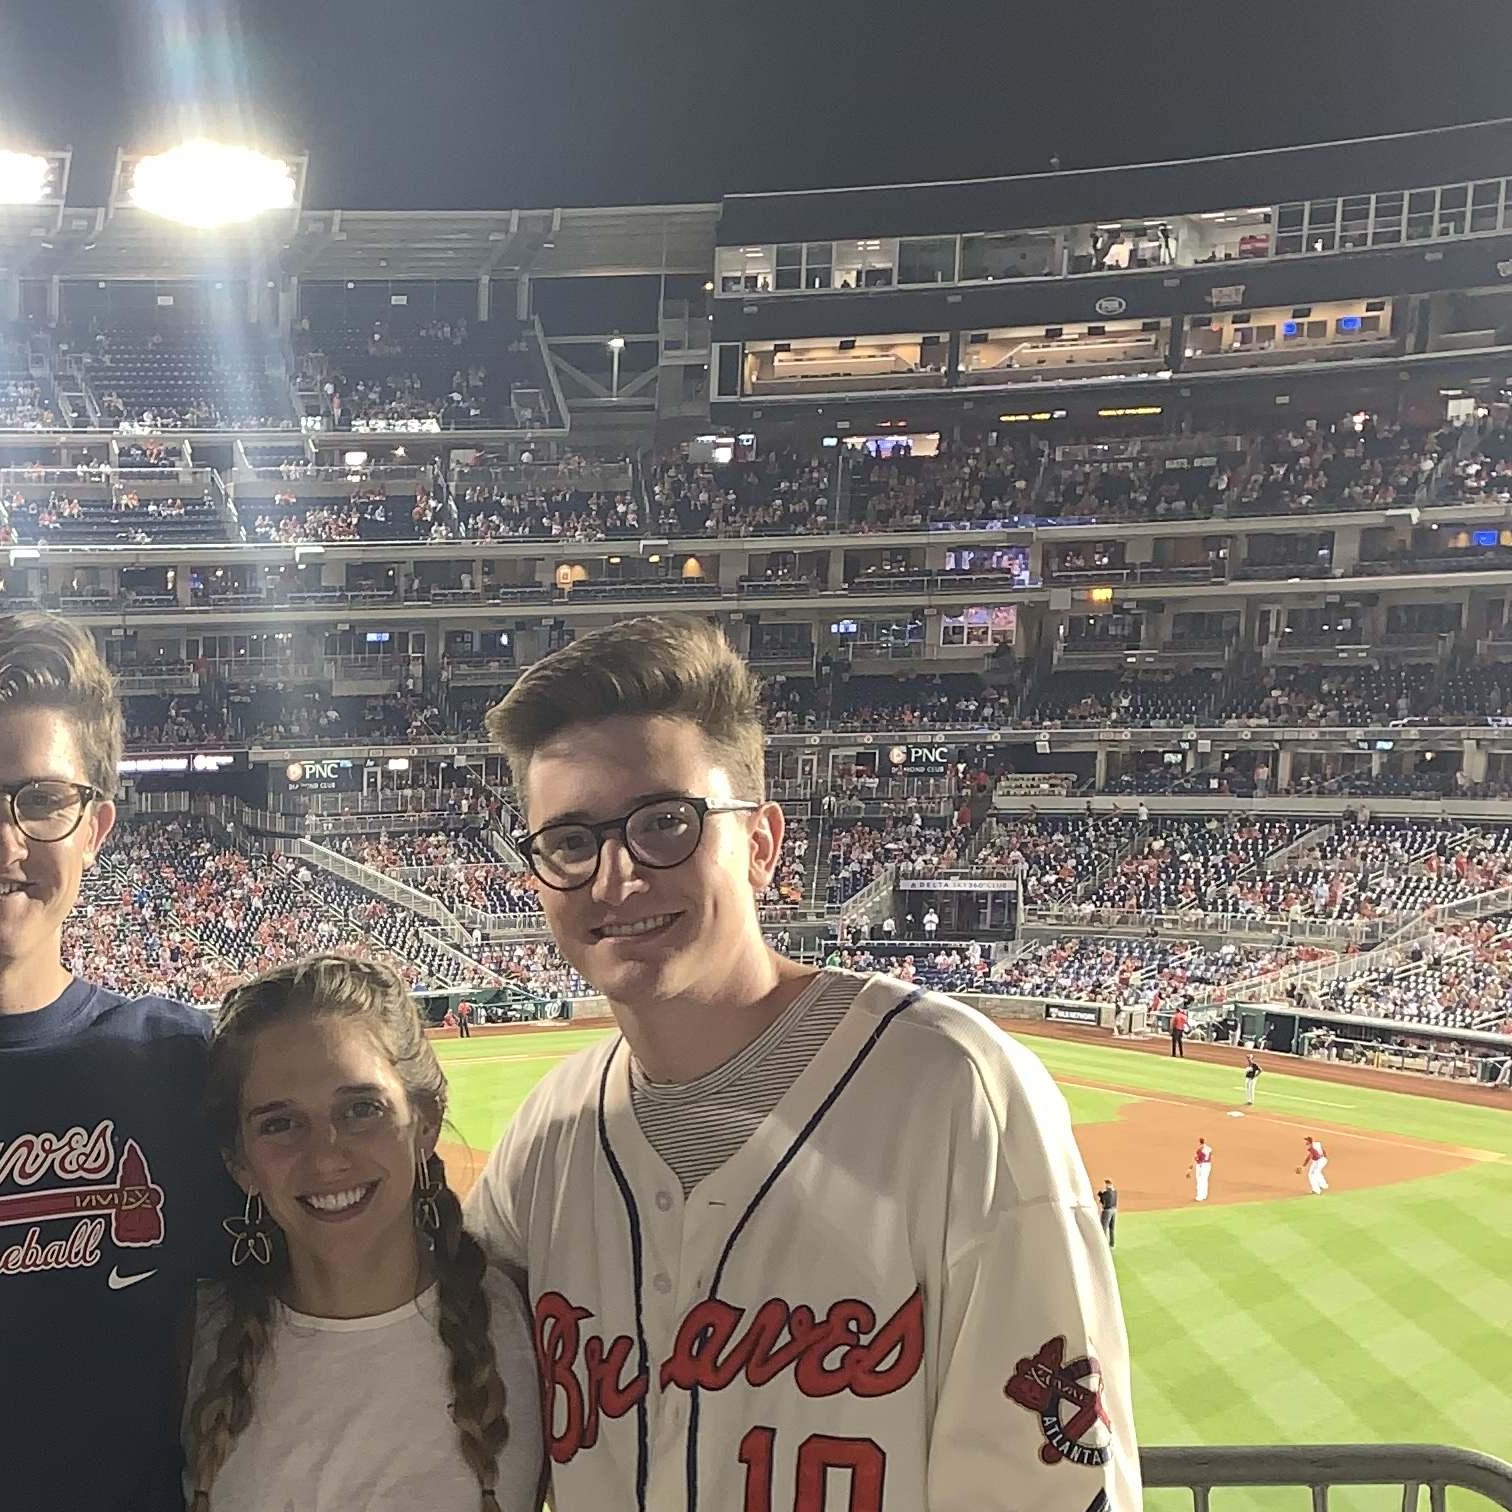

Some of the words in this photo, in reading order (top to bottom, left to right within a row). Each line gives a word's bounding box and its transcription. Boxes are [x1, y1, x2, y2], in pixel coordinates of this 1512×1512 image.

[910, 747, 948, 762] PNC
[304, 763, 338, 779] PNC
[535, 1283, 925, 1464] Braves
[1042, 1416, 1103, 1465] ATLANTA
